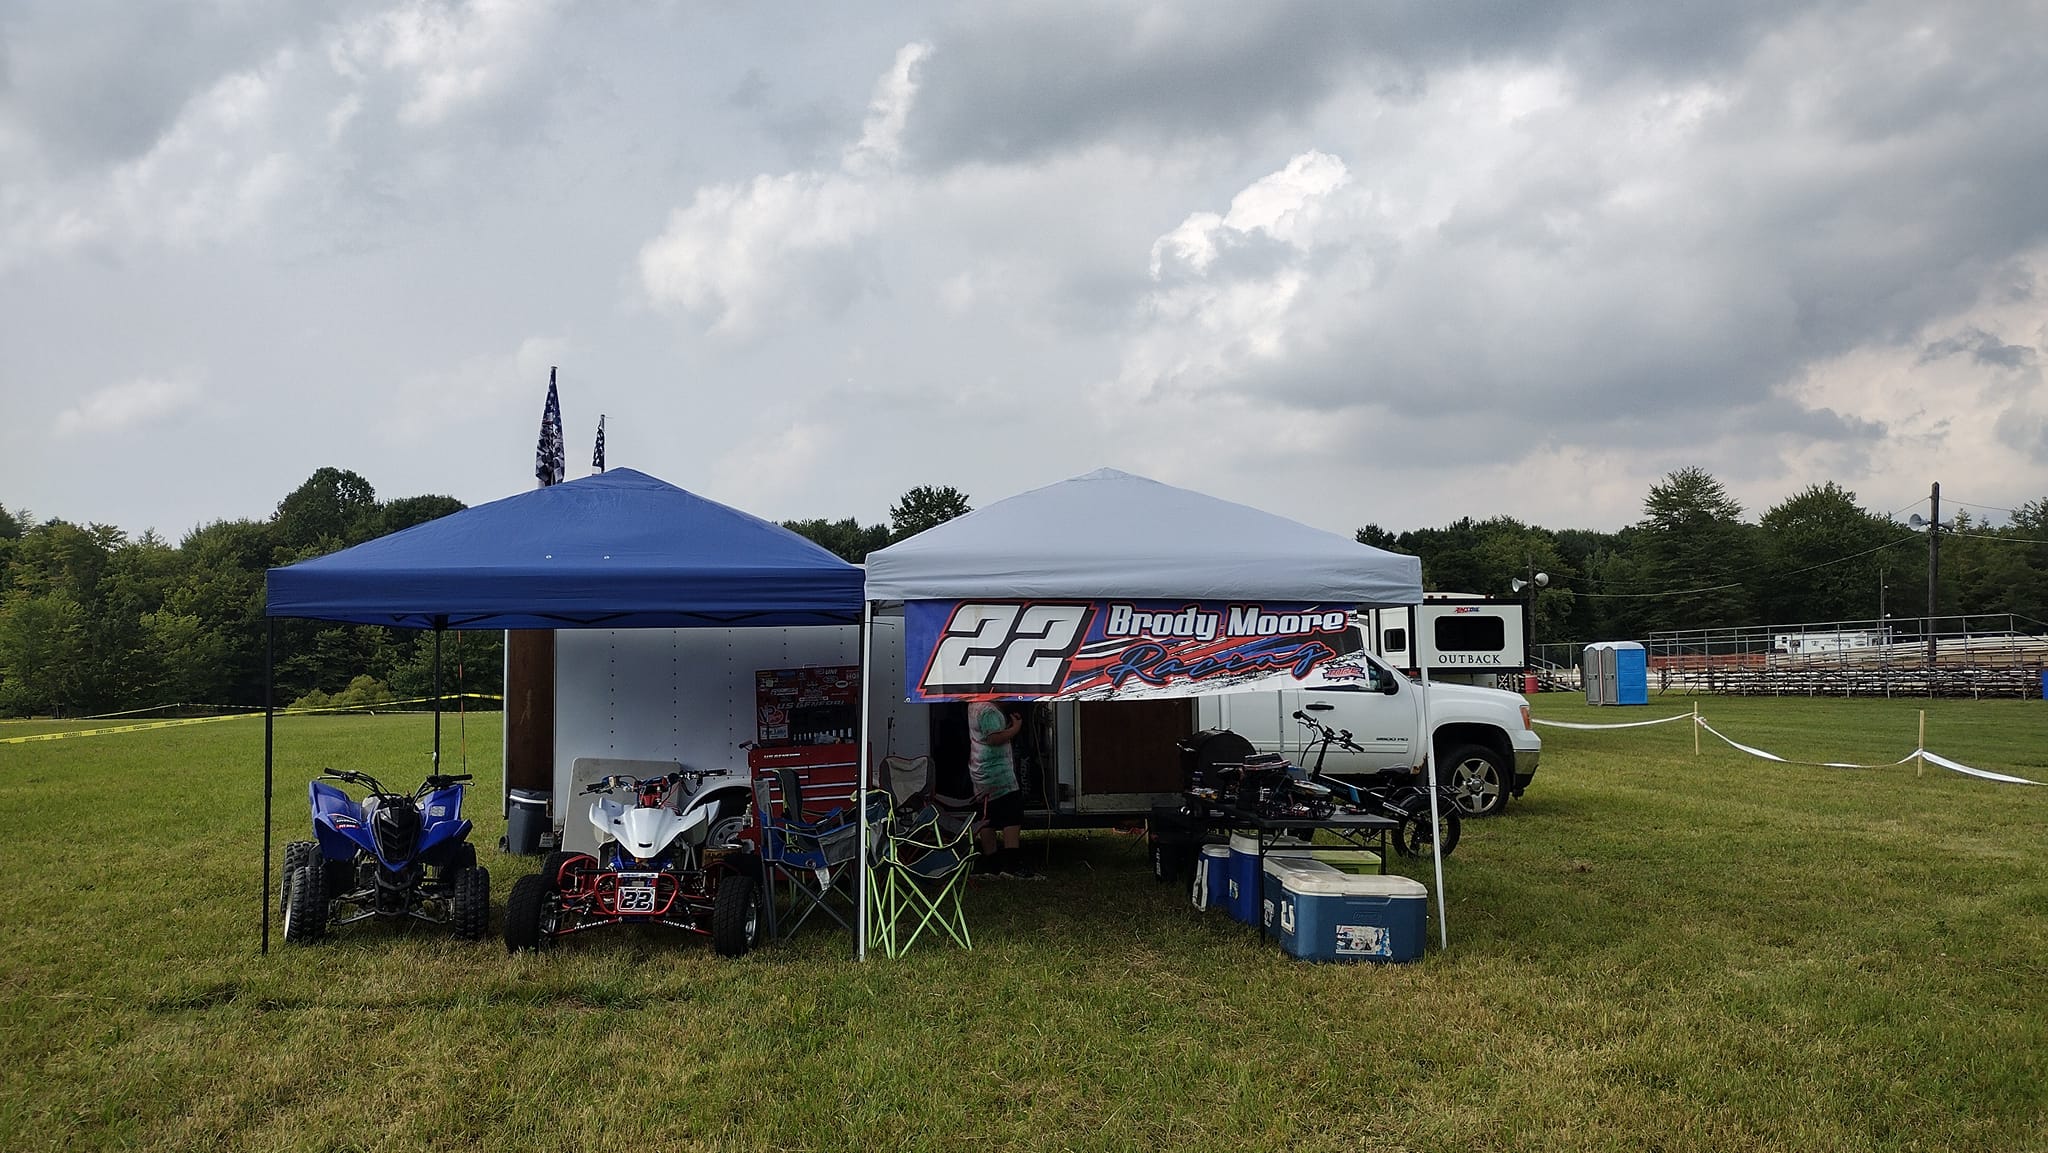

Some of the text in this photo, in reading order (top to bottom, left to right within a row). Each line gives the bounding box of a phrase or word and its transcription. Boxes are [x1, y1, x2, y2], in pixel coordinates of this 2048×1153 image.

[1106, 604, 1345, 640] Brody Moore
[922, 603, 1089, 687] 22
[1438, 653, 1501, 664] OUTBACK
[1105, 642, 1331, 687] Racing
[620, 890, 652, 910] 22
